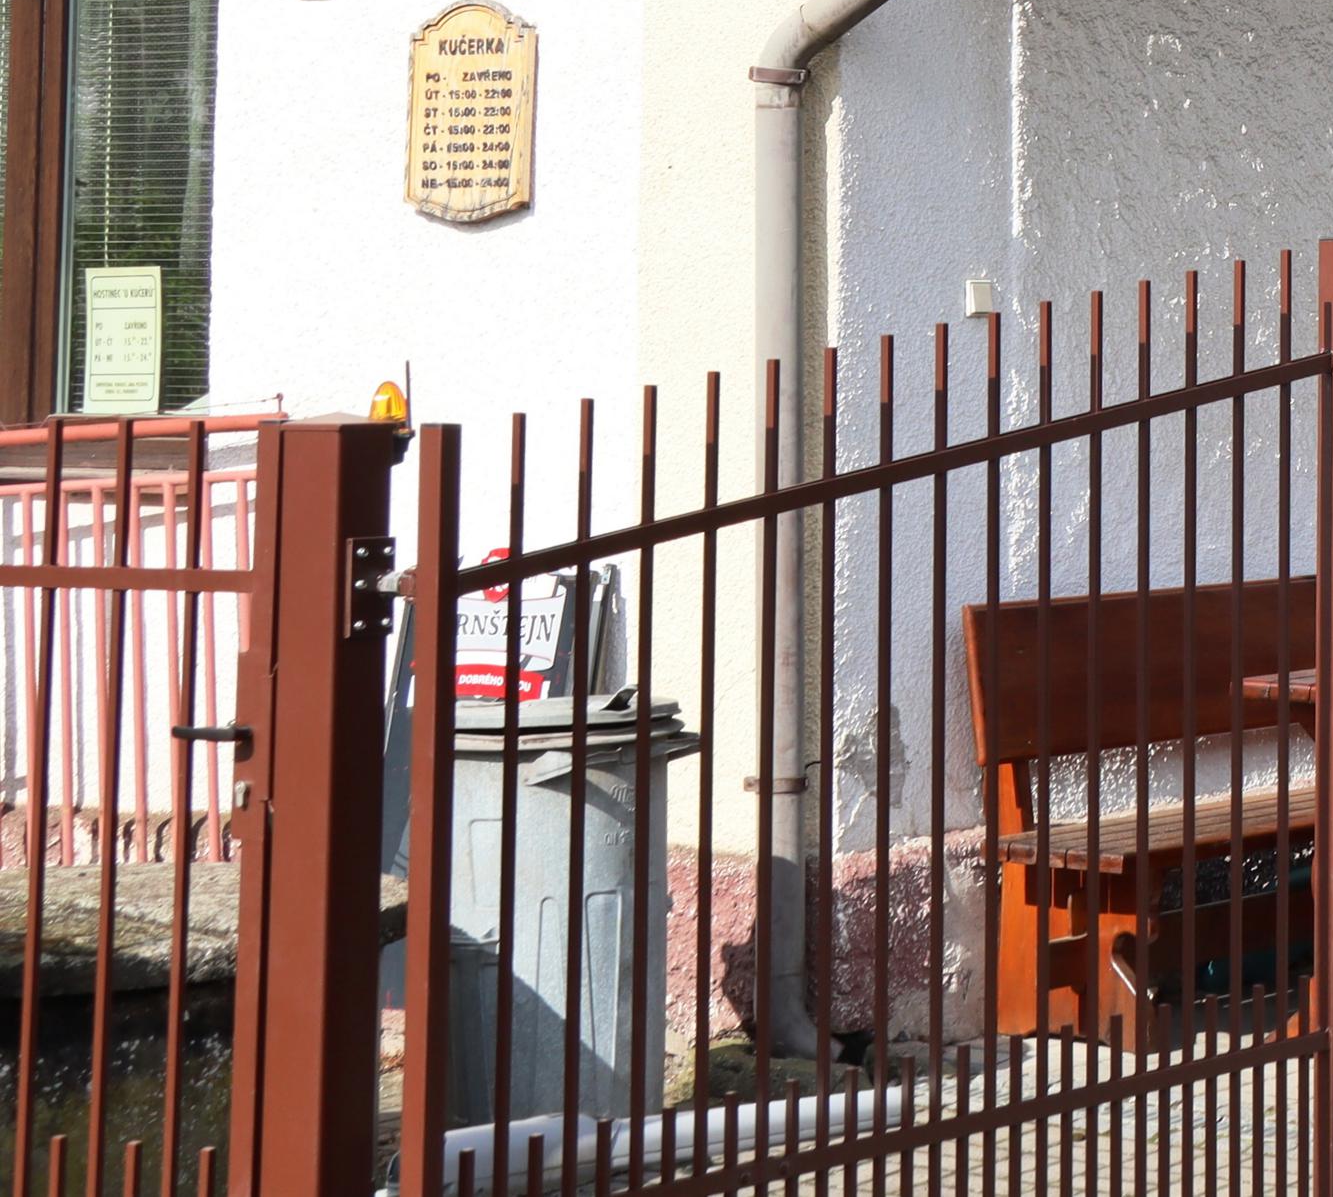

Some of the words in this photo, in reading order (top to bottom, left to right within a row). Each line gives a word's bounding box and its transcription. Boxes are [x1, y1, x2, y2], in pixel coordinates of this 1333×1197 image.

[438, 35, 505, 56] KUČERKA
[425, 72, 440, 83] PO
[462, 69, 513, 82] ZAVŘENO
[457, 609, 555, 645] RNŠEJN
[458, 673, 504, 687] DOBRÉHO
